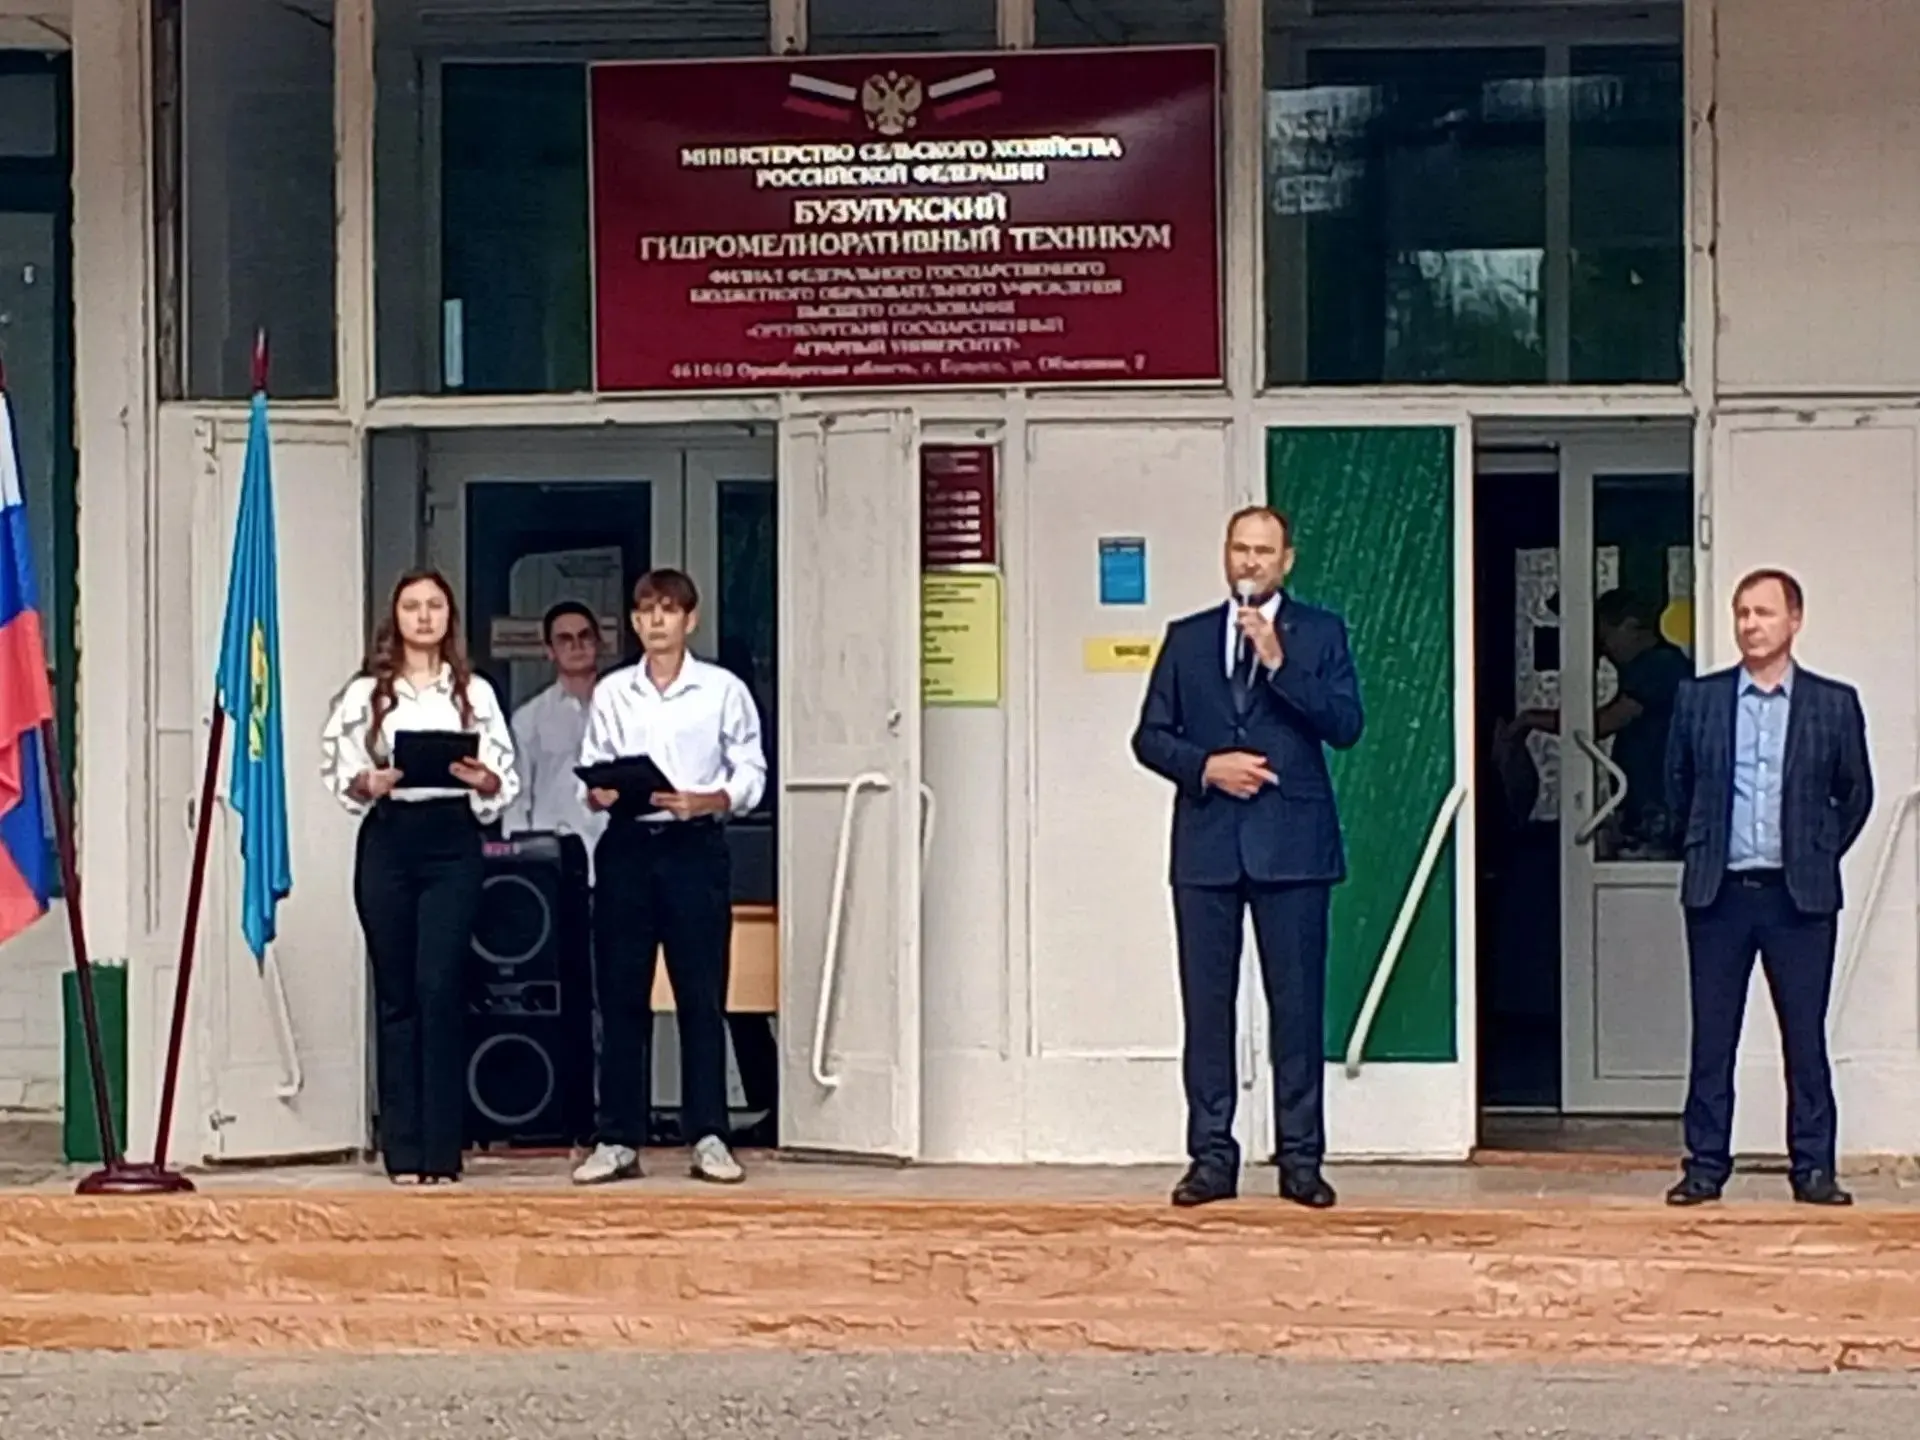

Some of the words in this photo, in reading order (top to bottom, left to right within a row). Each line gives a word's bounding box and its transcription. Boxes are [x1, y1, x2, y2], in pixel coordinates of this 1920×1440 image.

[795, 192, 1007, 224] БУЗУЛУКСКИЙ
[640, 224, 1000, 260] ГИДРОМЕЛИОРАТИВНЫЙ
[1008, 224, 1171, 251] ТЕХНИКУМ
